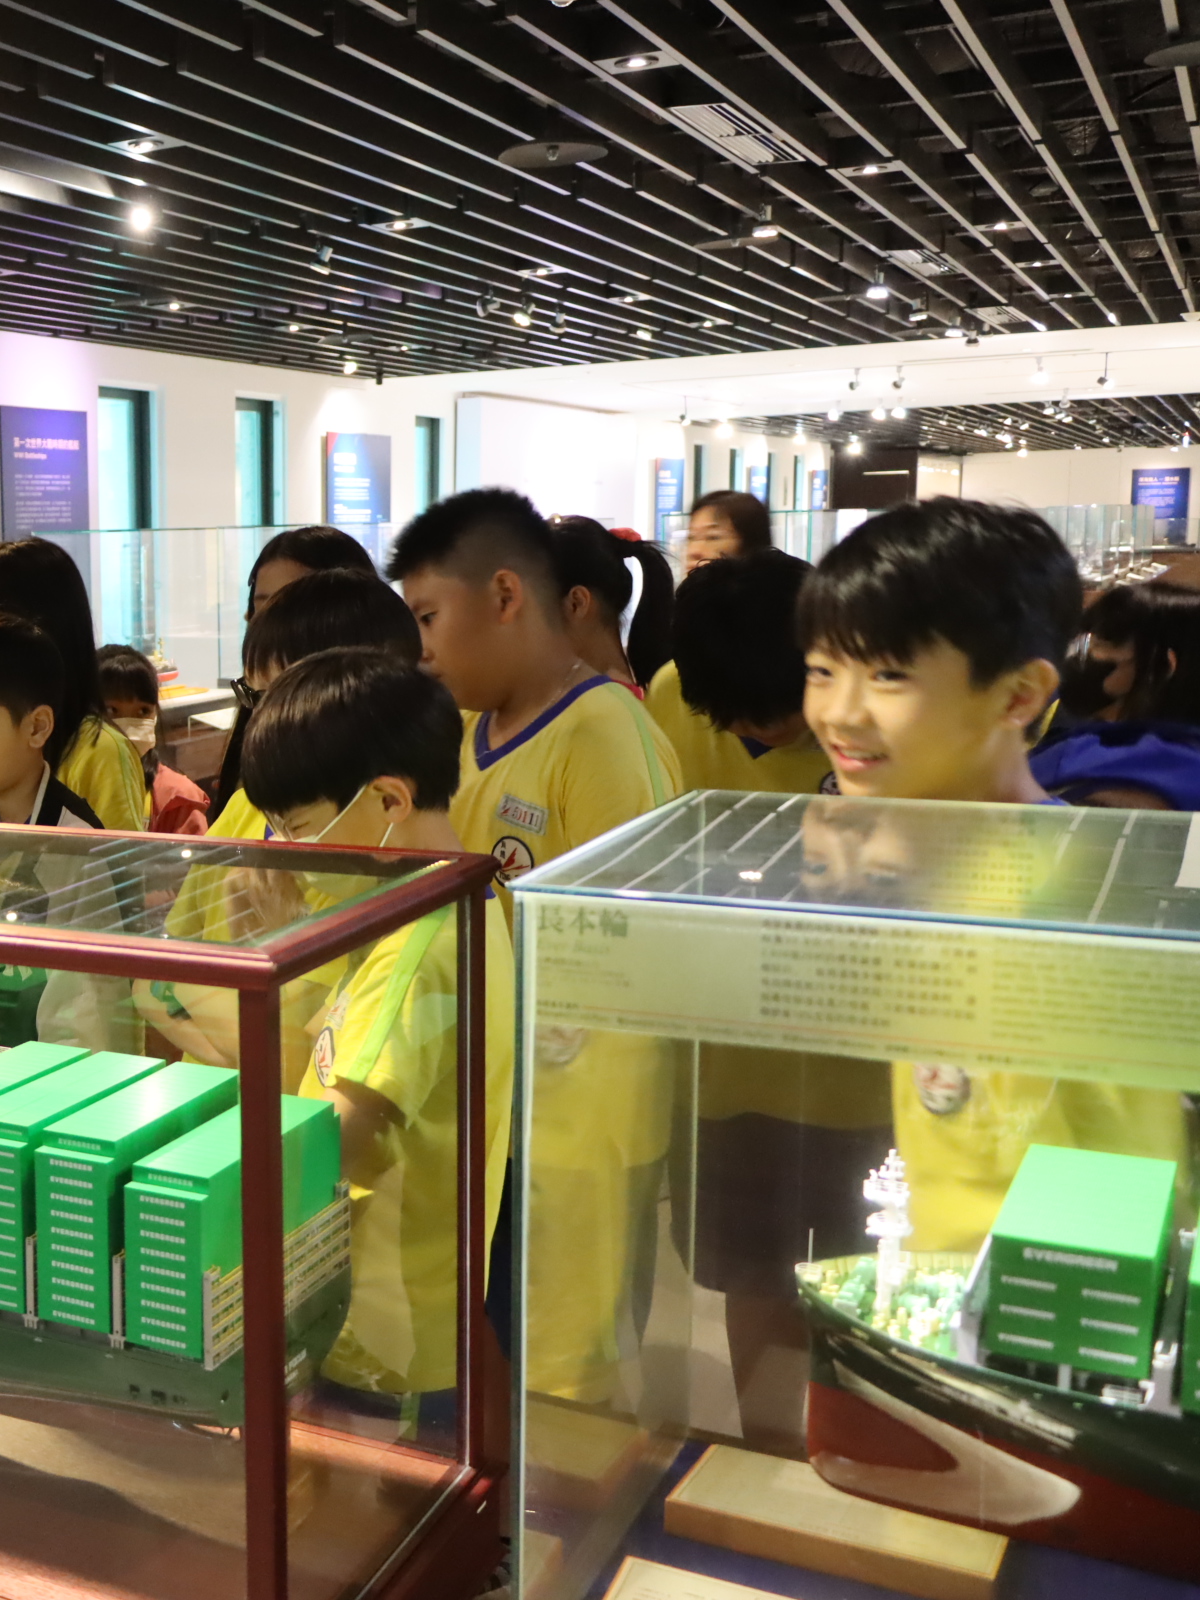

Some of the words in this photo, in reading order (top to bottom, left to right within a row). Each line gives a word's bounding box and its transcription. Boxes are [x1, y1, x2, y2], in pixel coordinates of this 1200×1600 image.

[50, 1158, 94, 1171] EVERGREEN
[50, 1176, 93, 1189] EVERGREEN
[50, 1193, 93, 1206] EVERGREEN
[140, 1195, 186, 1208] EVERGREEN
[51, 1210, 93, 1223] EVERGREEN
[140, 1213, 185, 1227] EVERGREEN
[51, 1227, 93, 1240] EVERGREEN
[140, 1230, 185, 1244] EVERGREEN
[51, 1244, 94, 1257] EVERGREEN
[141, 1247, 186, 1261] EVERGREEN
[52, 1260, 94, 1274] EVERGREEN
[140, 1265, 186, 1279] EVERGREEN
[52, 1277, 94, 1291] EVERGREEN
[141, 1282, 186, 1297] EVERGREEN
[52, 1294, 94, 1308] EVERGREEN
[141, 1299, 186, 1314] EVERGREEN
[53, 1310, 95, 1325] EVERGREEN
[141, 1317, 186, 1331] EVERGREEN
[141, 1334, 186, 1348] EVERGREEN
